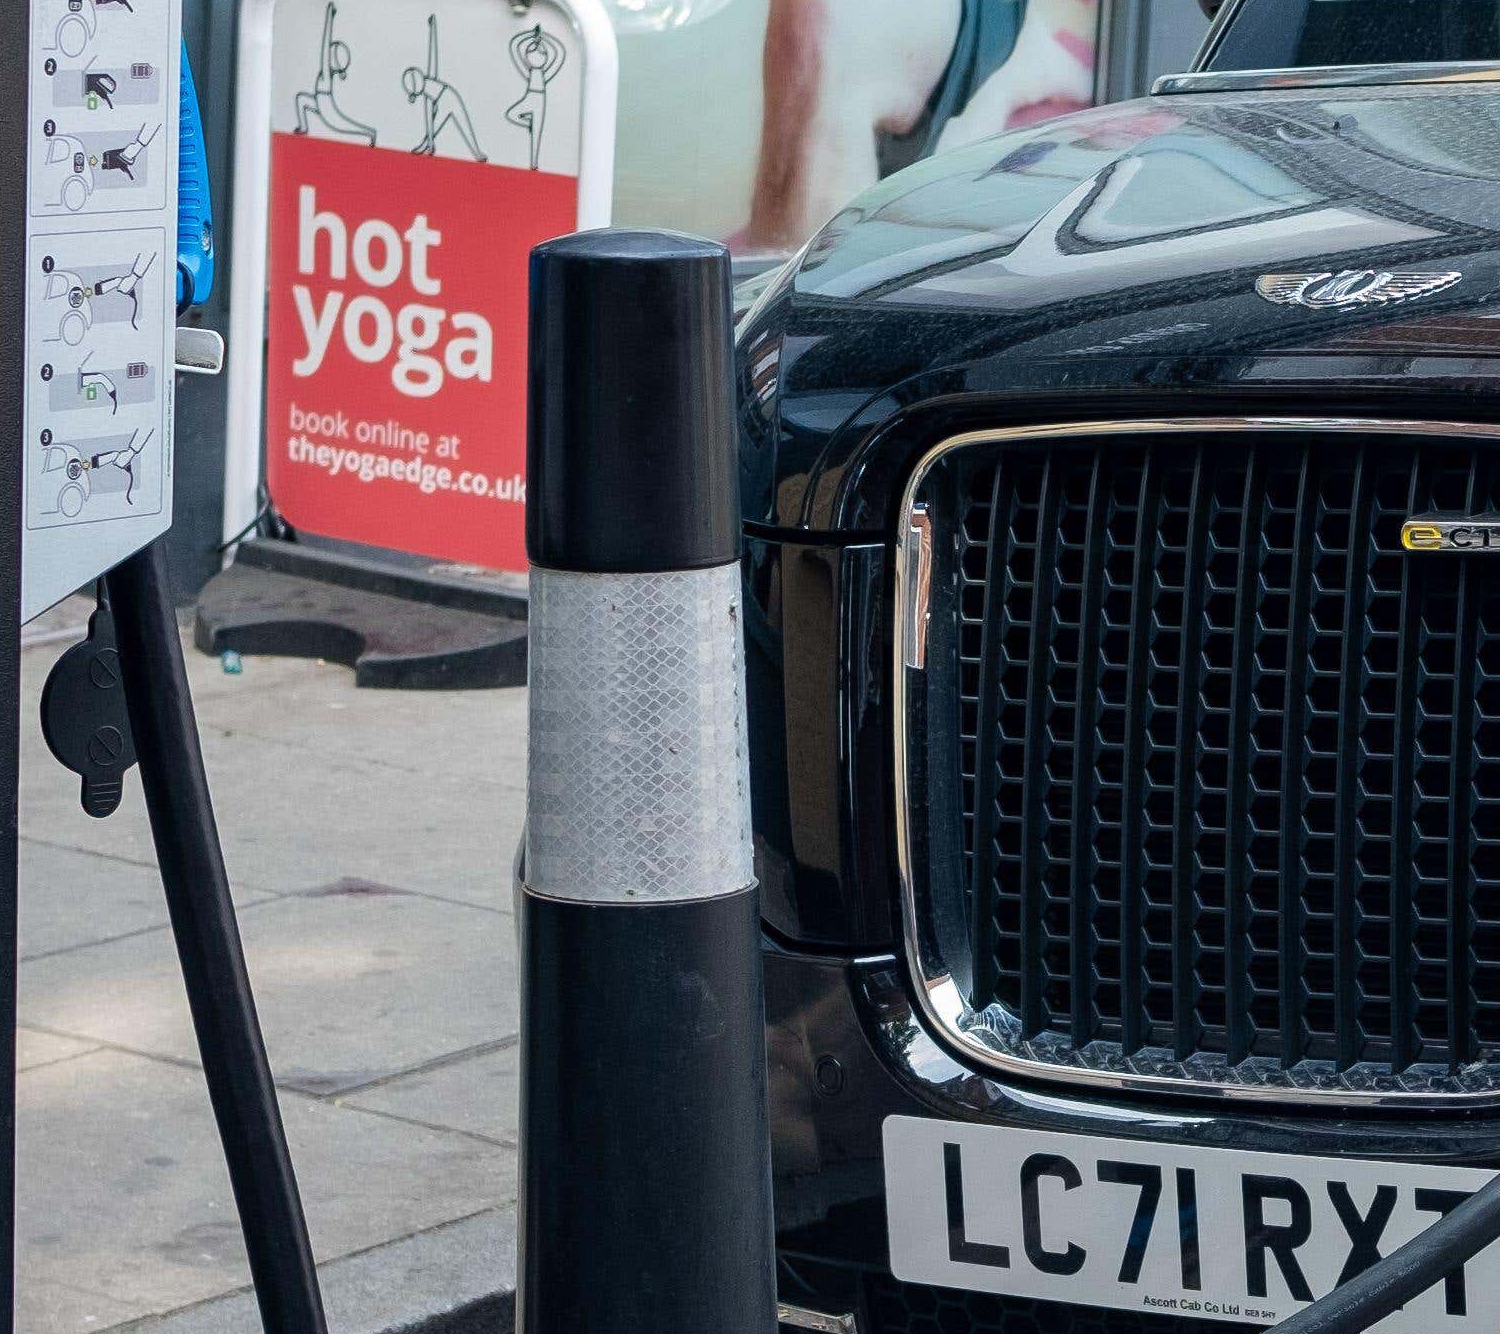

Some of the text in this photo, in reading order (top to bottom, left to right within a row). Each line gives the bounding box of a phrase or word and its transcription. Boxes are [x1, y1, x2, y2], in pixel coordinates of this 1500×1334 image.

[298, 185, 442, 296] hot
[292, 284, 493, 399] yoga
[287, 436, 528, 505] theyogaedge.co.uk
[289, 402, 460, 460] book online at
[942, 1142, 1482, 1317] LC71 RXT
[1143, 1295, 1177, 1309] Ascott
[1179, 1298, 1202, 1311] Cab
[1204, 1301, 1219, 1314] Co
[1222, 1303, 1240, 1316] Ltd
